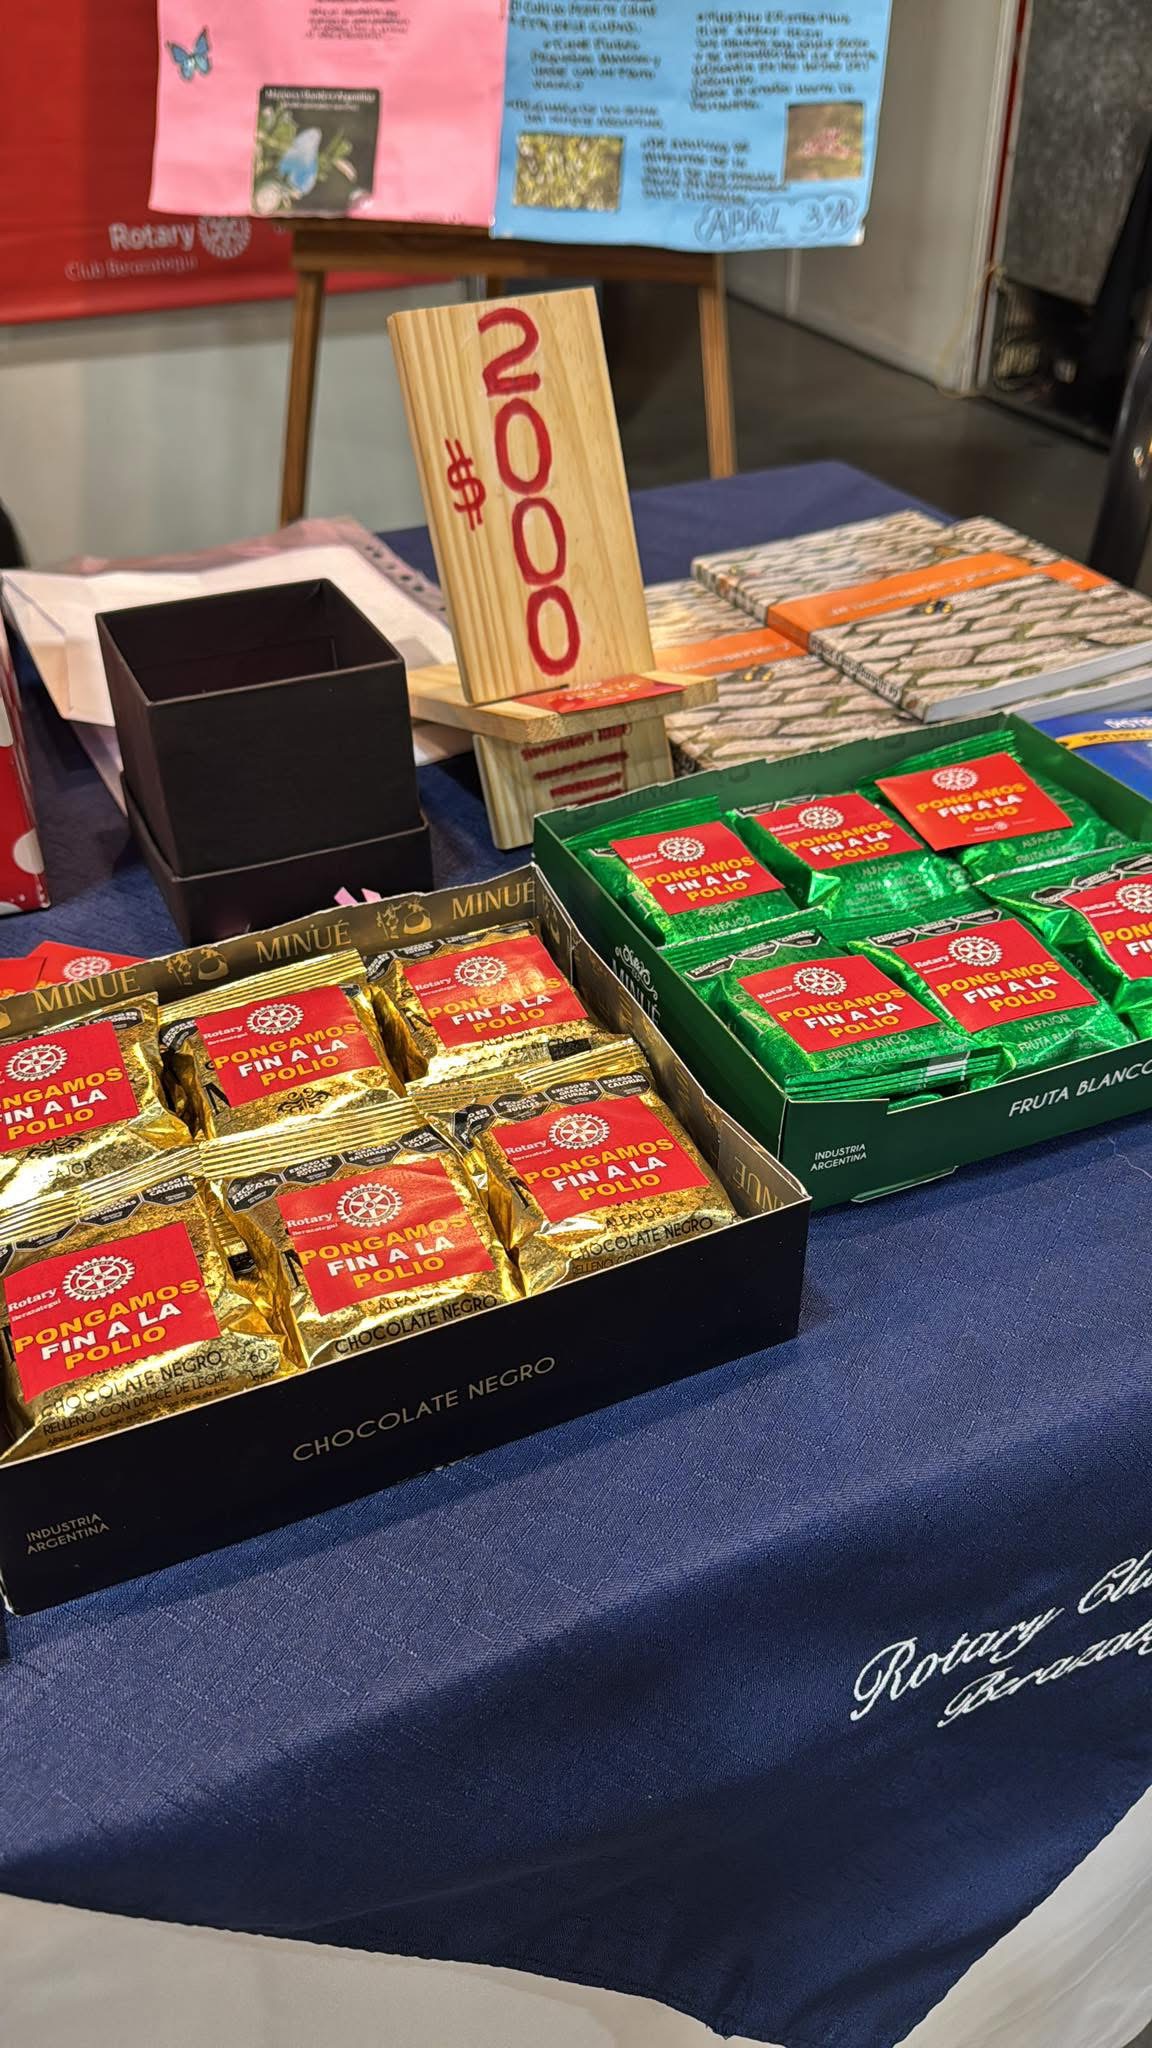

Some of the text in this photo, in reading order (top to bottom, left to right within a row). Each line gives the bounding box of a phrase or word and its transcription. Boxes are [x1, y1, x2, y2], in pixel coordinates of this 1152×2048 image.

[108, 222, 195, 251] Rotary
[444, 437, 487, 532] $
[477, 306, 581, 677] 2000
[915, 783, 1028, 813] PONGAMOS
[937, 794, 1023, 818] FIN A LA
[957, 806, 1020, 824] POLIO
[788, 819, 894, 851] PONGAMOS
[809, 831, 892, 856] FIN A LA
[625, 851, 658, 865] Rotary
[830, 842, 890, 862] POLIO
[642, 856, 755, 888] PONGAMOS
[664, 869, 751, 895] FIN A LA
[452, 877, 536, 920] MINUÉ
[686, 881, 748, 902] POLIO
[255, 919, 352, 964] MINUÉ
[913, 954, 949, 970] Rotary
[415, 977, 452, 991] Rotary
[757, 985, 793, 999] Rotary
[936, 960, 1060, 997] PONGAMOS
[963, 975, 1059, 1004] FIN A LA
[451, 993, 552, 1027] FIN A LA
[777, 988, 907, 1022] PONGAMOS
[803, 1001, 903, 1029] FIN A LA
[988, 988, 1057, 1012] POLIO
[203, 1024, 243, 1039] Rotary
[473, 1008, 545, 1033] POLIO
[828, 1016, 900, 1038] POLIO
[214, 1023, 361, 1069] PONGAMOS
[238, 1039, 349, 1077] FIN A LA
[826, 1047, 860, 1061] FRUTA
[862, 1033, 910, 1052] BLANCO
[259, 1055, 339, 1087] POLIO
[43, 1100, 64, 1115] A
[70, 1088, 108, 1108] LA
[551, 1084, 580, 1093] EXCESO
[1008, 1086, 1069, 1118] FRUTA
[8, 1108, 94, 1140] POLIO
[505, 1139, 547, 1155] Rotary
[524, 1137, 675, 1185] PONGAMOS
[810, 1152, 867, 1172] ARGENTINA
[814, 1143, 866, 1161] INDUSTRIA
[552, 1156, 667, 1192] FIN A LA
[577, 1172, 661, 1201] POLIO
[287, 1211, 333, 1228] Rotary
[605, 1206, 664, 1230] ALFAJOR
[300, 1216, 467, 1265] PONGAMOS
[568, 1216, 713, 1261] CHOCOLATE NEGRO
[327, 1235, 455, 1277] FIN A LA
[352, 1257, 445, 1289] POLIO
[8, 1288, 57, 1313] Rotary
[15, 1279, 201, 1353] PONGAMOS
[41, 1303, 182, 1360] FIN A LA
[335, 1294, 498, 1354] CHOCOLATE NEGRO
[65, 1326, 167, 1370] POLIO
[41, 1370, 154, 1419] CHOCOLATE
[160, 1350, 222, 1381] NEGRO
[42, 1371, 228, 1436] RELLENO CON DULCE DE LECHE
[293, 1388, 460, 1462] CHOCOLATE
[468, 1355, 557, 1402] NEGRO
[26, 1513, 102, 1543] INDUSTRIA
[27, 1521, 110, 1555] ARGENTINA
[850, 1607, 1065, 1721] Rotary
